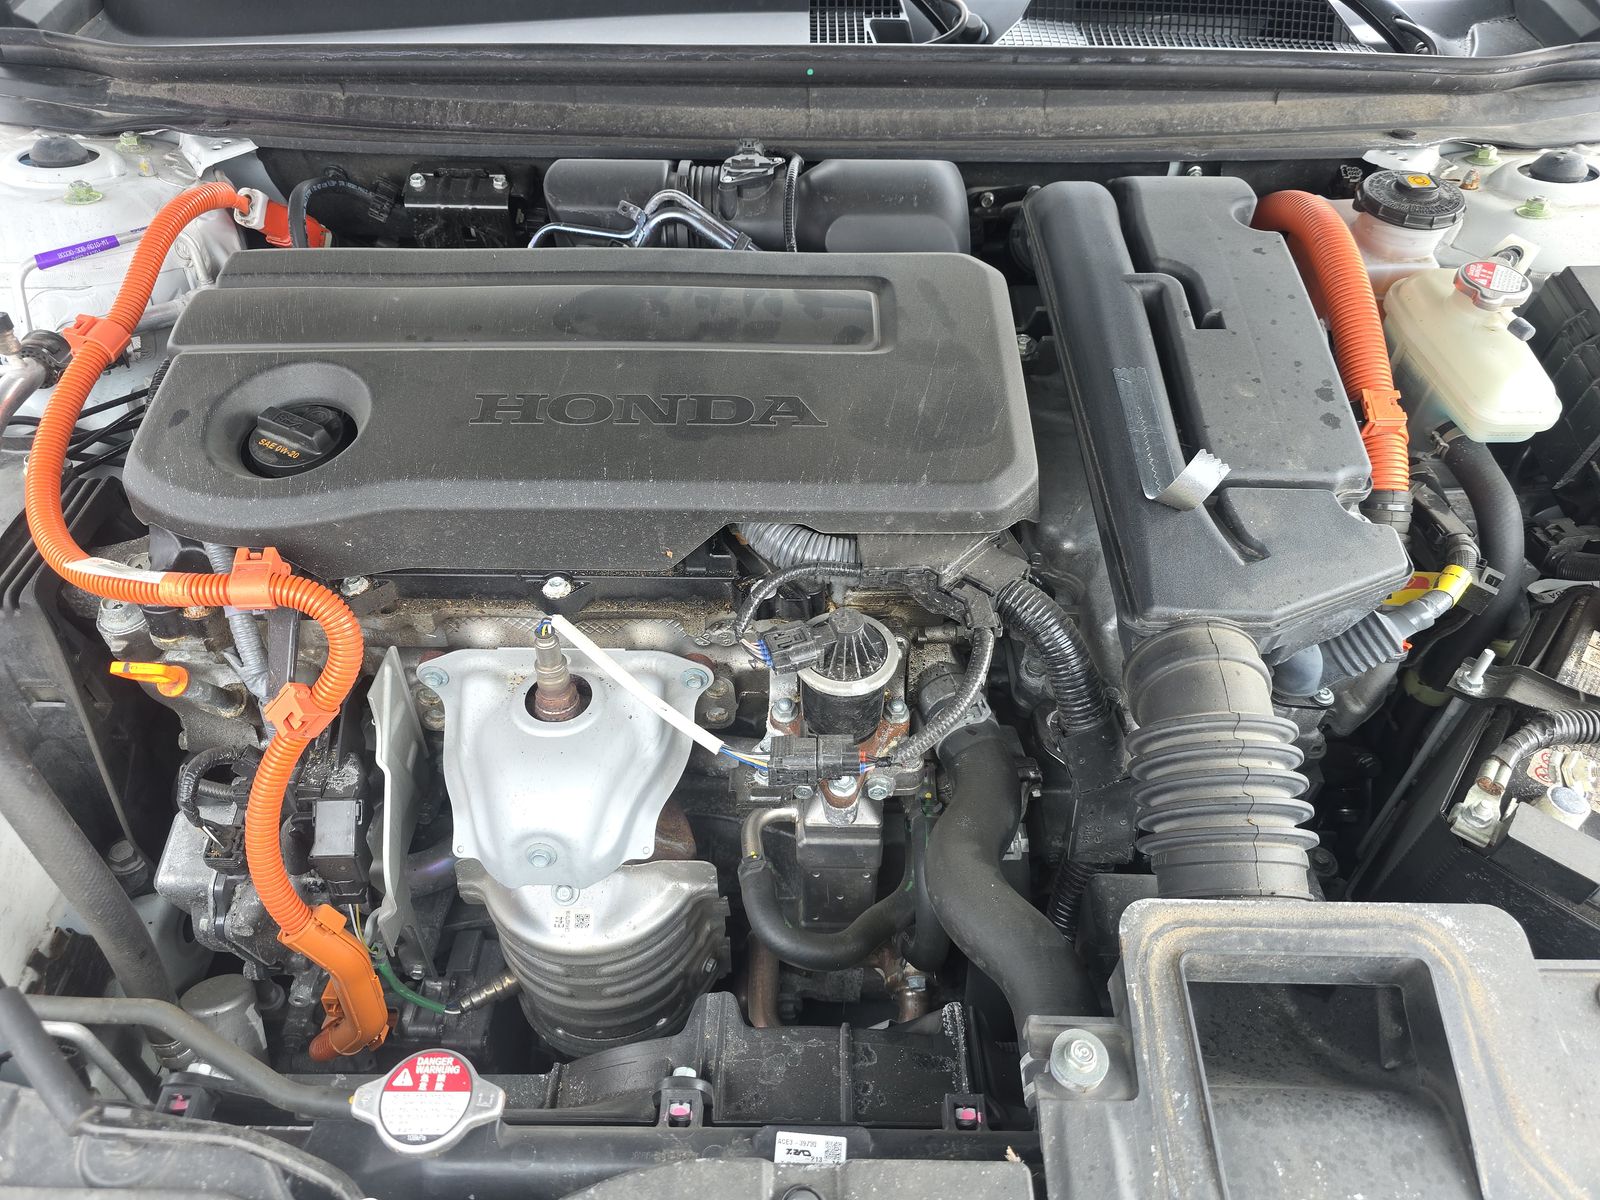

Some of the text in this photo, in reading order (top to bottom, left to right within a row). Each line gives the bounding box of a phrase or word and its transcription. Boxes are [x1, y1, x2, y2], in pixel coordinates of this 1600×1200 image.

[468, 392, 829, 427] HONDA
[258, 438, 300, 459] SAE 0W-20
[417, 1056, 454, 1066] DANGER
